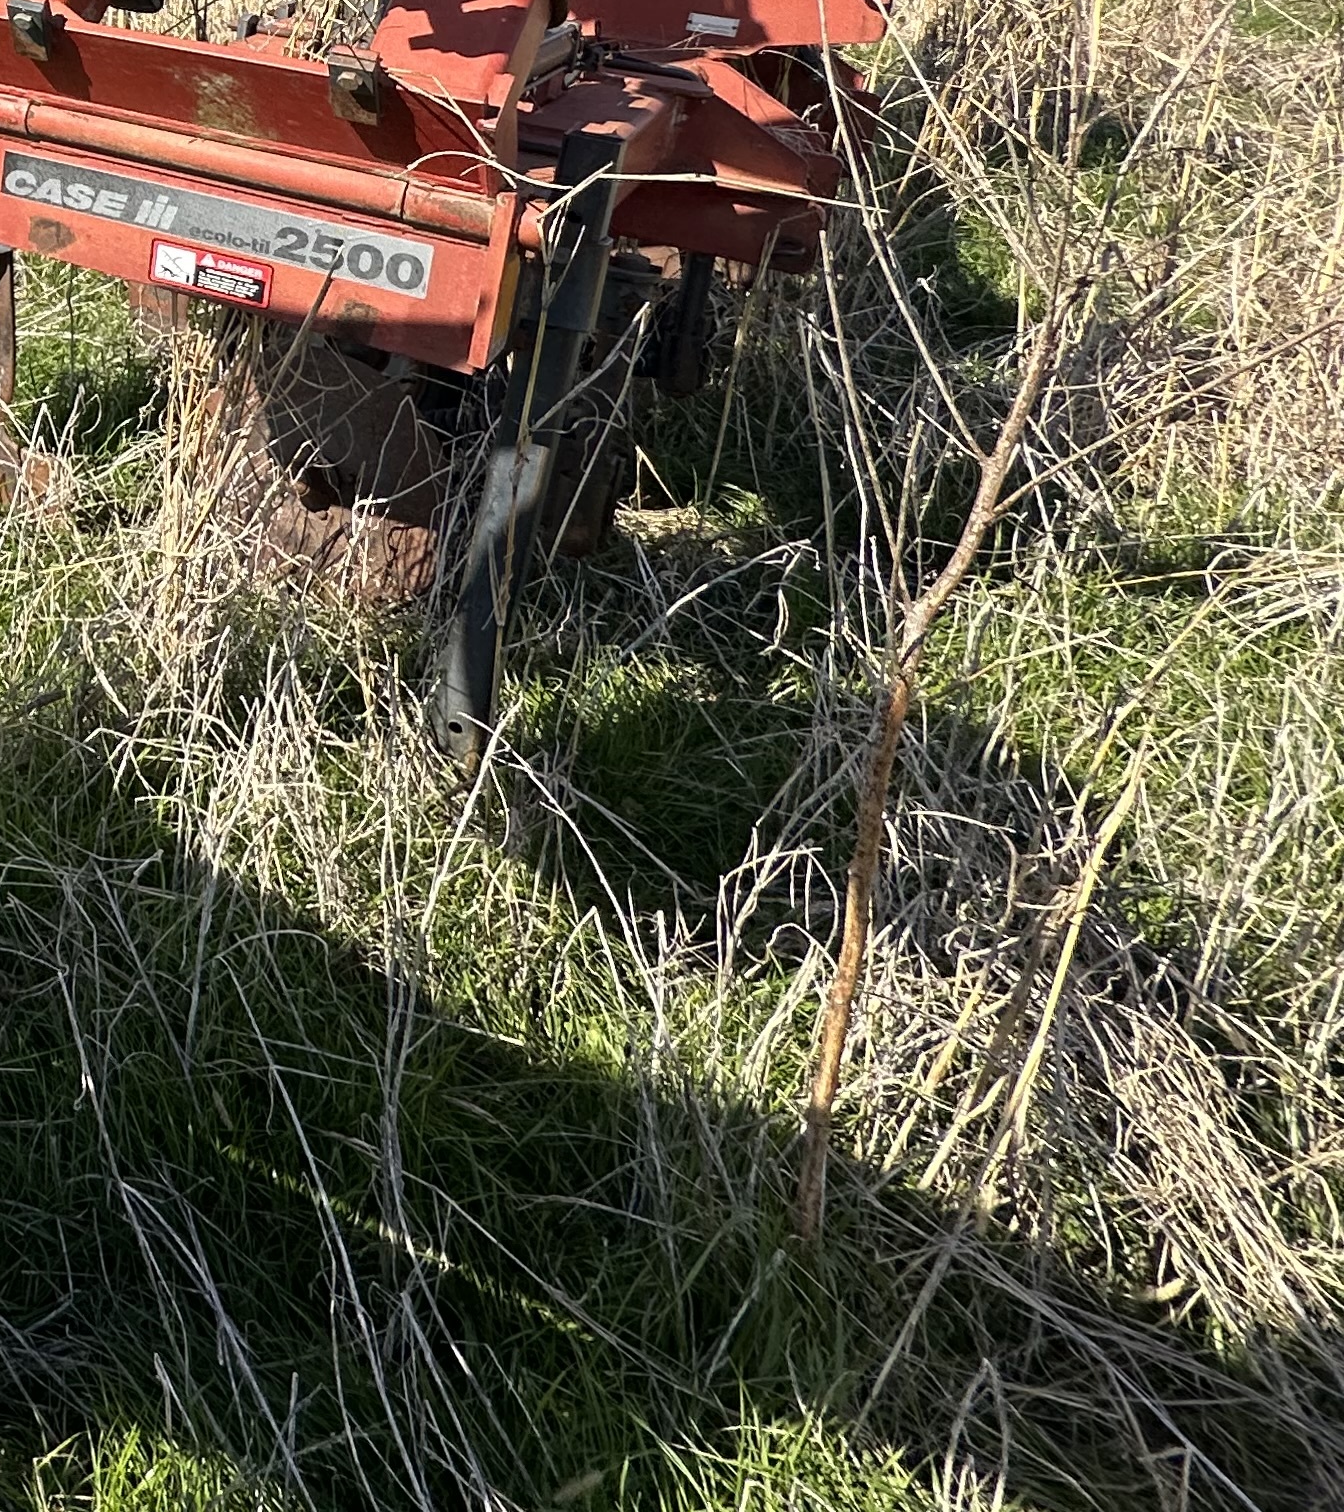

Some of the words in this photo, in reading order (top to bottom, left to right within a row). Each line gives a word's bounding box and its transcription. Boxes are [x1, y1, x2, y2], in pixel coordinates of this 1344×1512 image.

[4, 169, 129, 219] CASE
[188, 225, 272, 256] ecolo-til
[272, 226, 425, 290] 2500
[216, 259, 264, 279] DANGER
